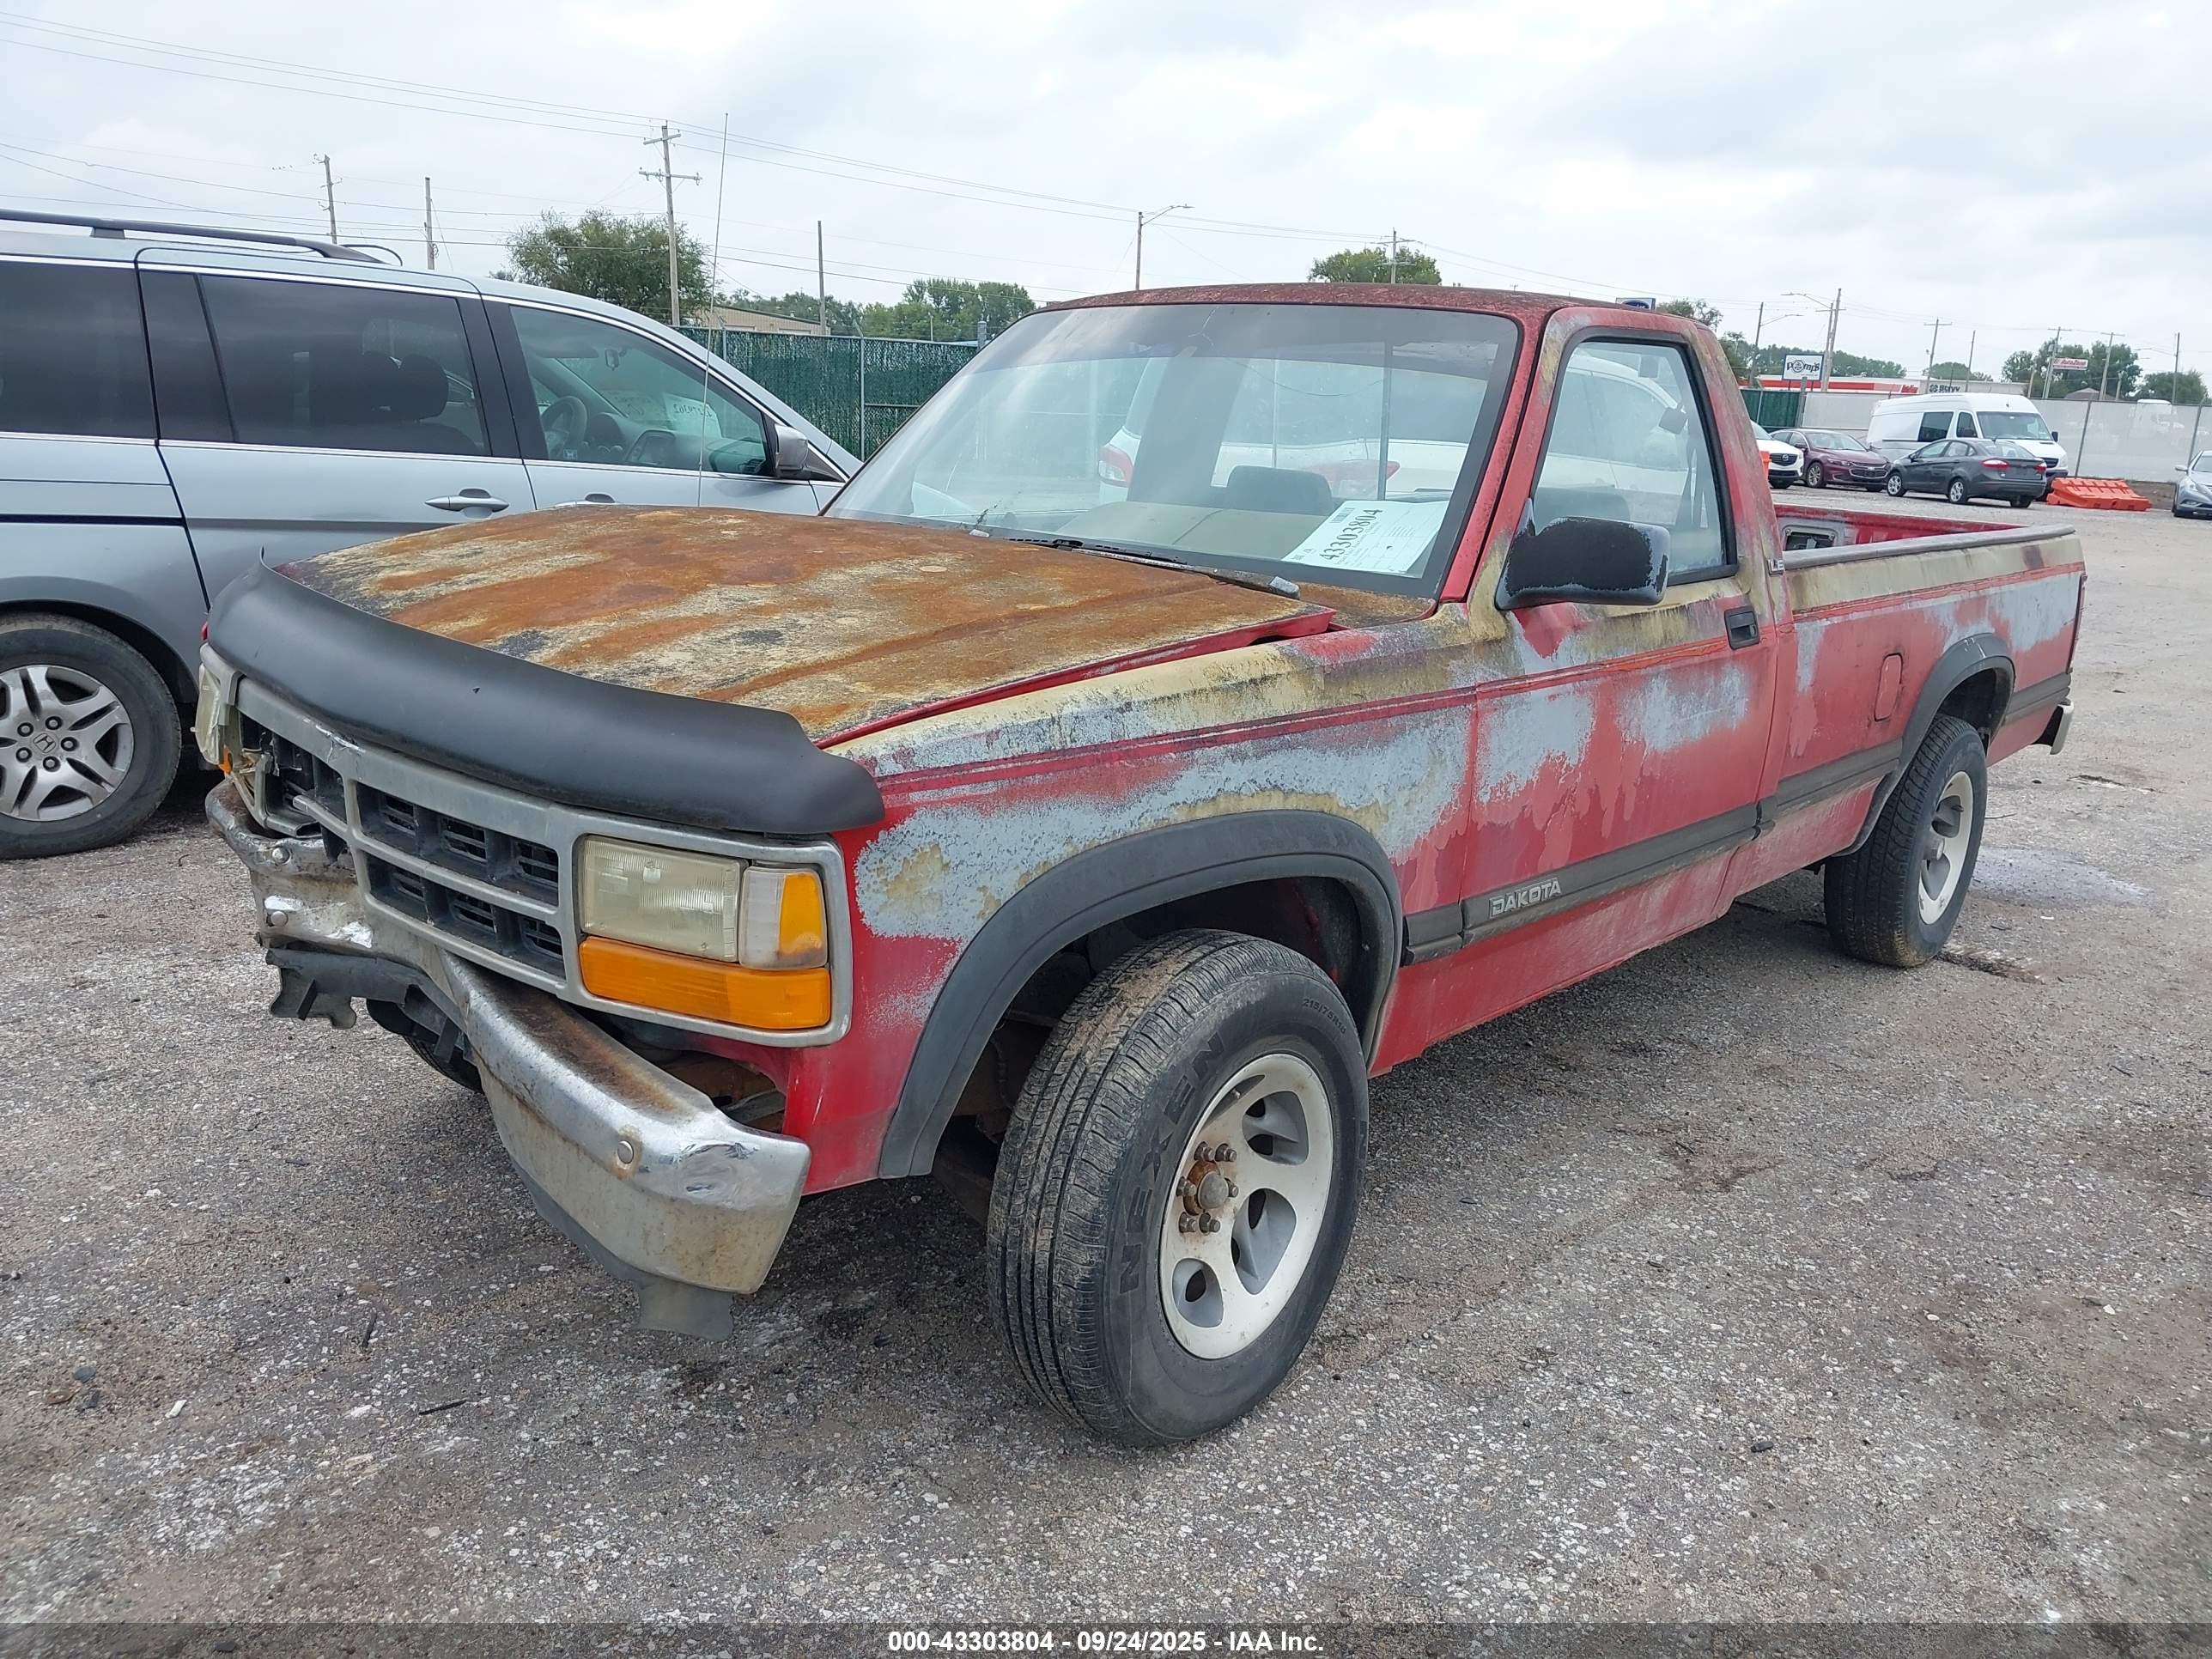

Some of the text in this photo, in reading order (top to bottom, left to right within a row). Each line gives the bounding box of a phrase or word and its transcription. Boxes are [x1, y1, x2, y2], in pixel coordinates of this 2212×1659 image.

[1319, 508, 1383, 561] 43303804
[1492, 879, 1562, 916] DAKOTA
[1119, 1032, 1228, 1294] NEXEN
